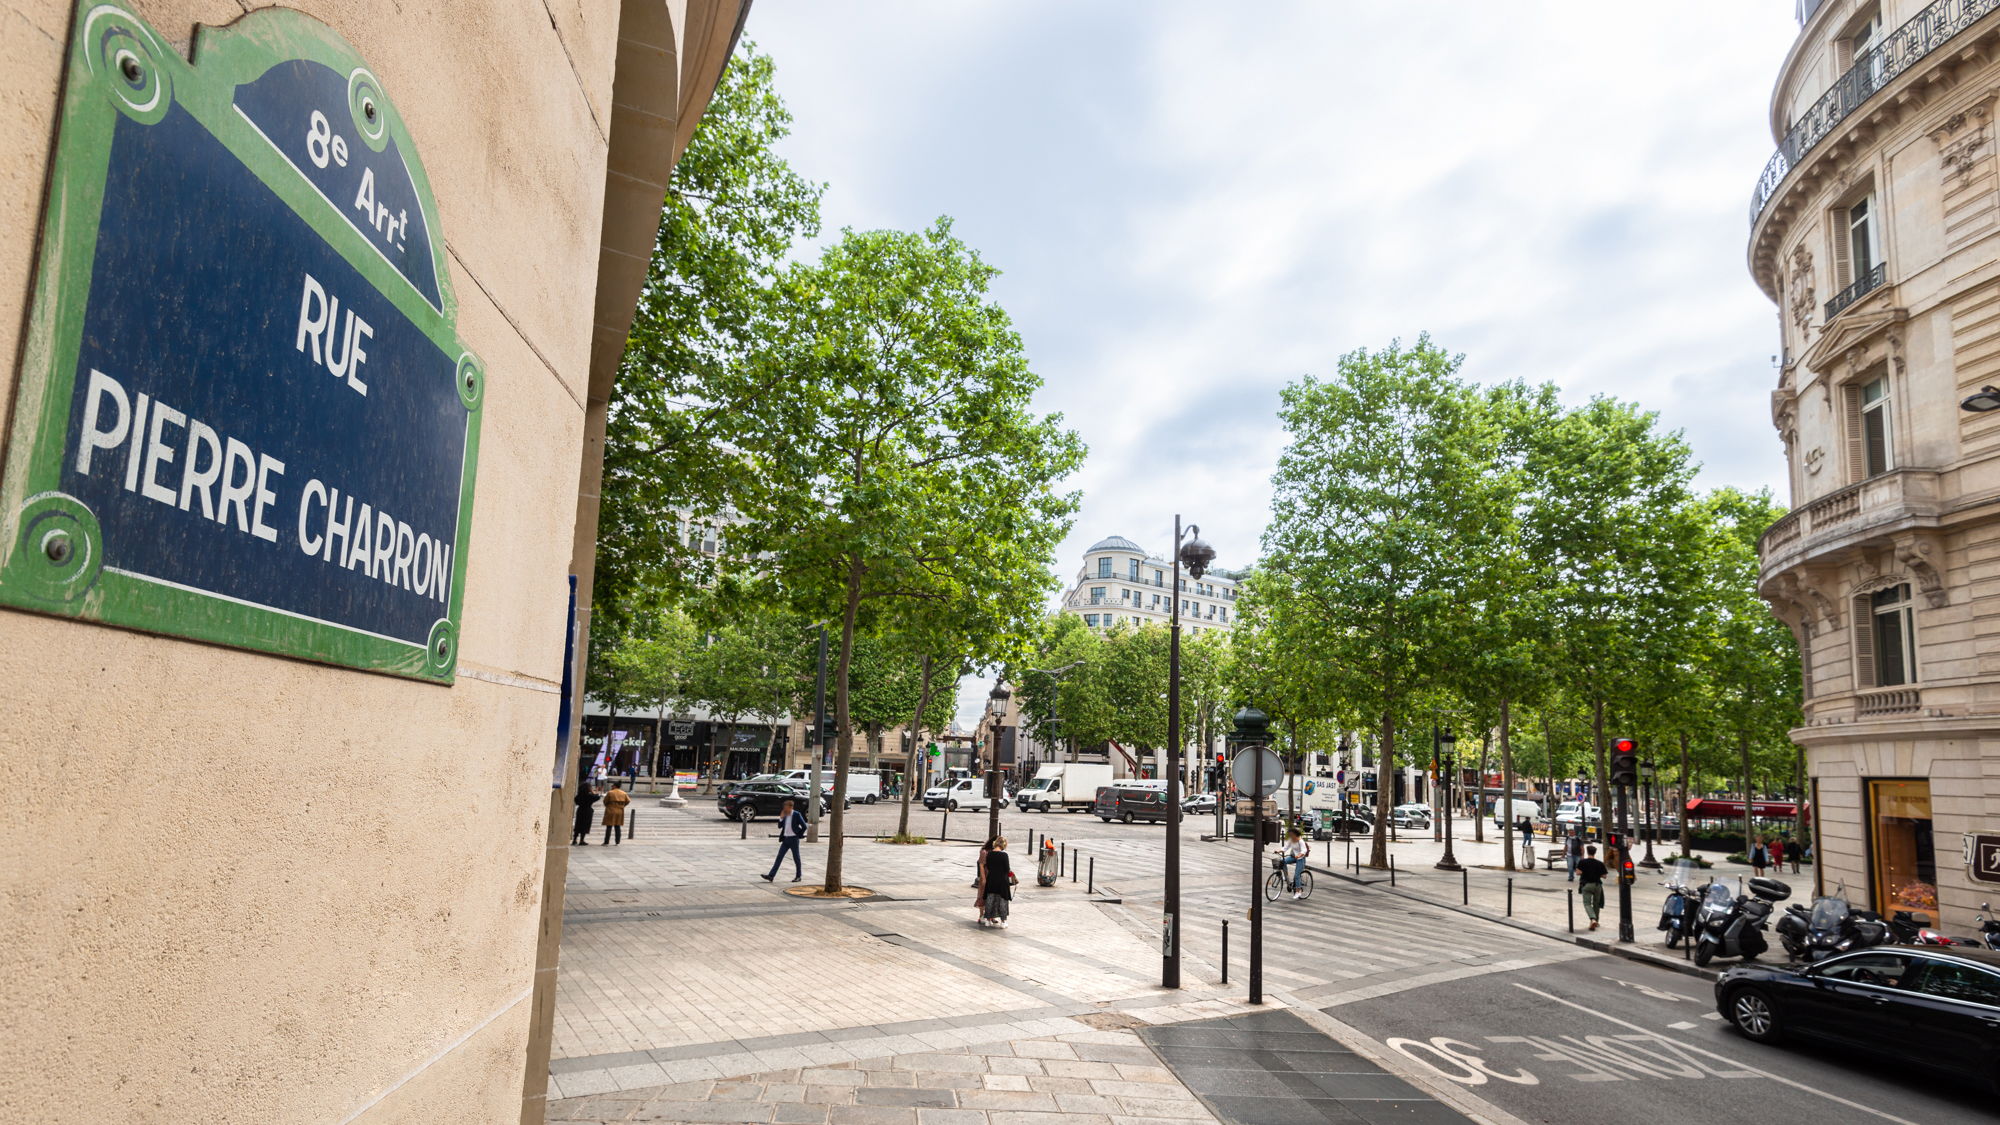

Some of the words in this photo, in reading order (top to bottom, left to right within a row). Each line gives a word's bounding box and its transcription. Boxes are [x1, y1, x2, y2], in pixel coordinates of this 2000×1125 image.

[306, 110, 348, 169] 8e
[296, 273, 374, 397] RUE
[75, 369, 286, 543] PIERRE
[298, 479, 450, 603] CHARRON
[1386, 1036, 1540, 1085] 30
[1483, 1033, 1765, 1082] ZONE
